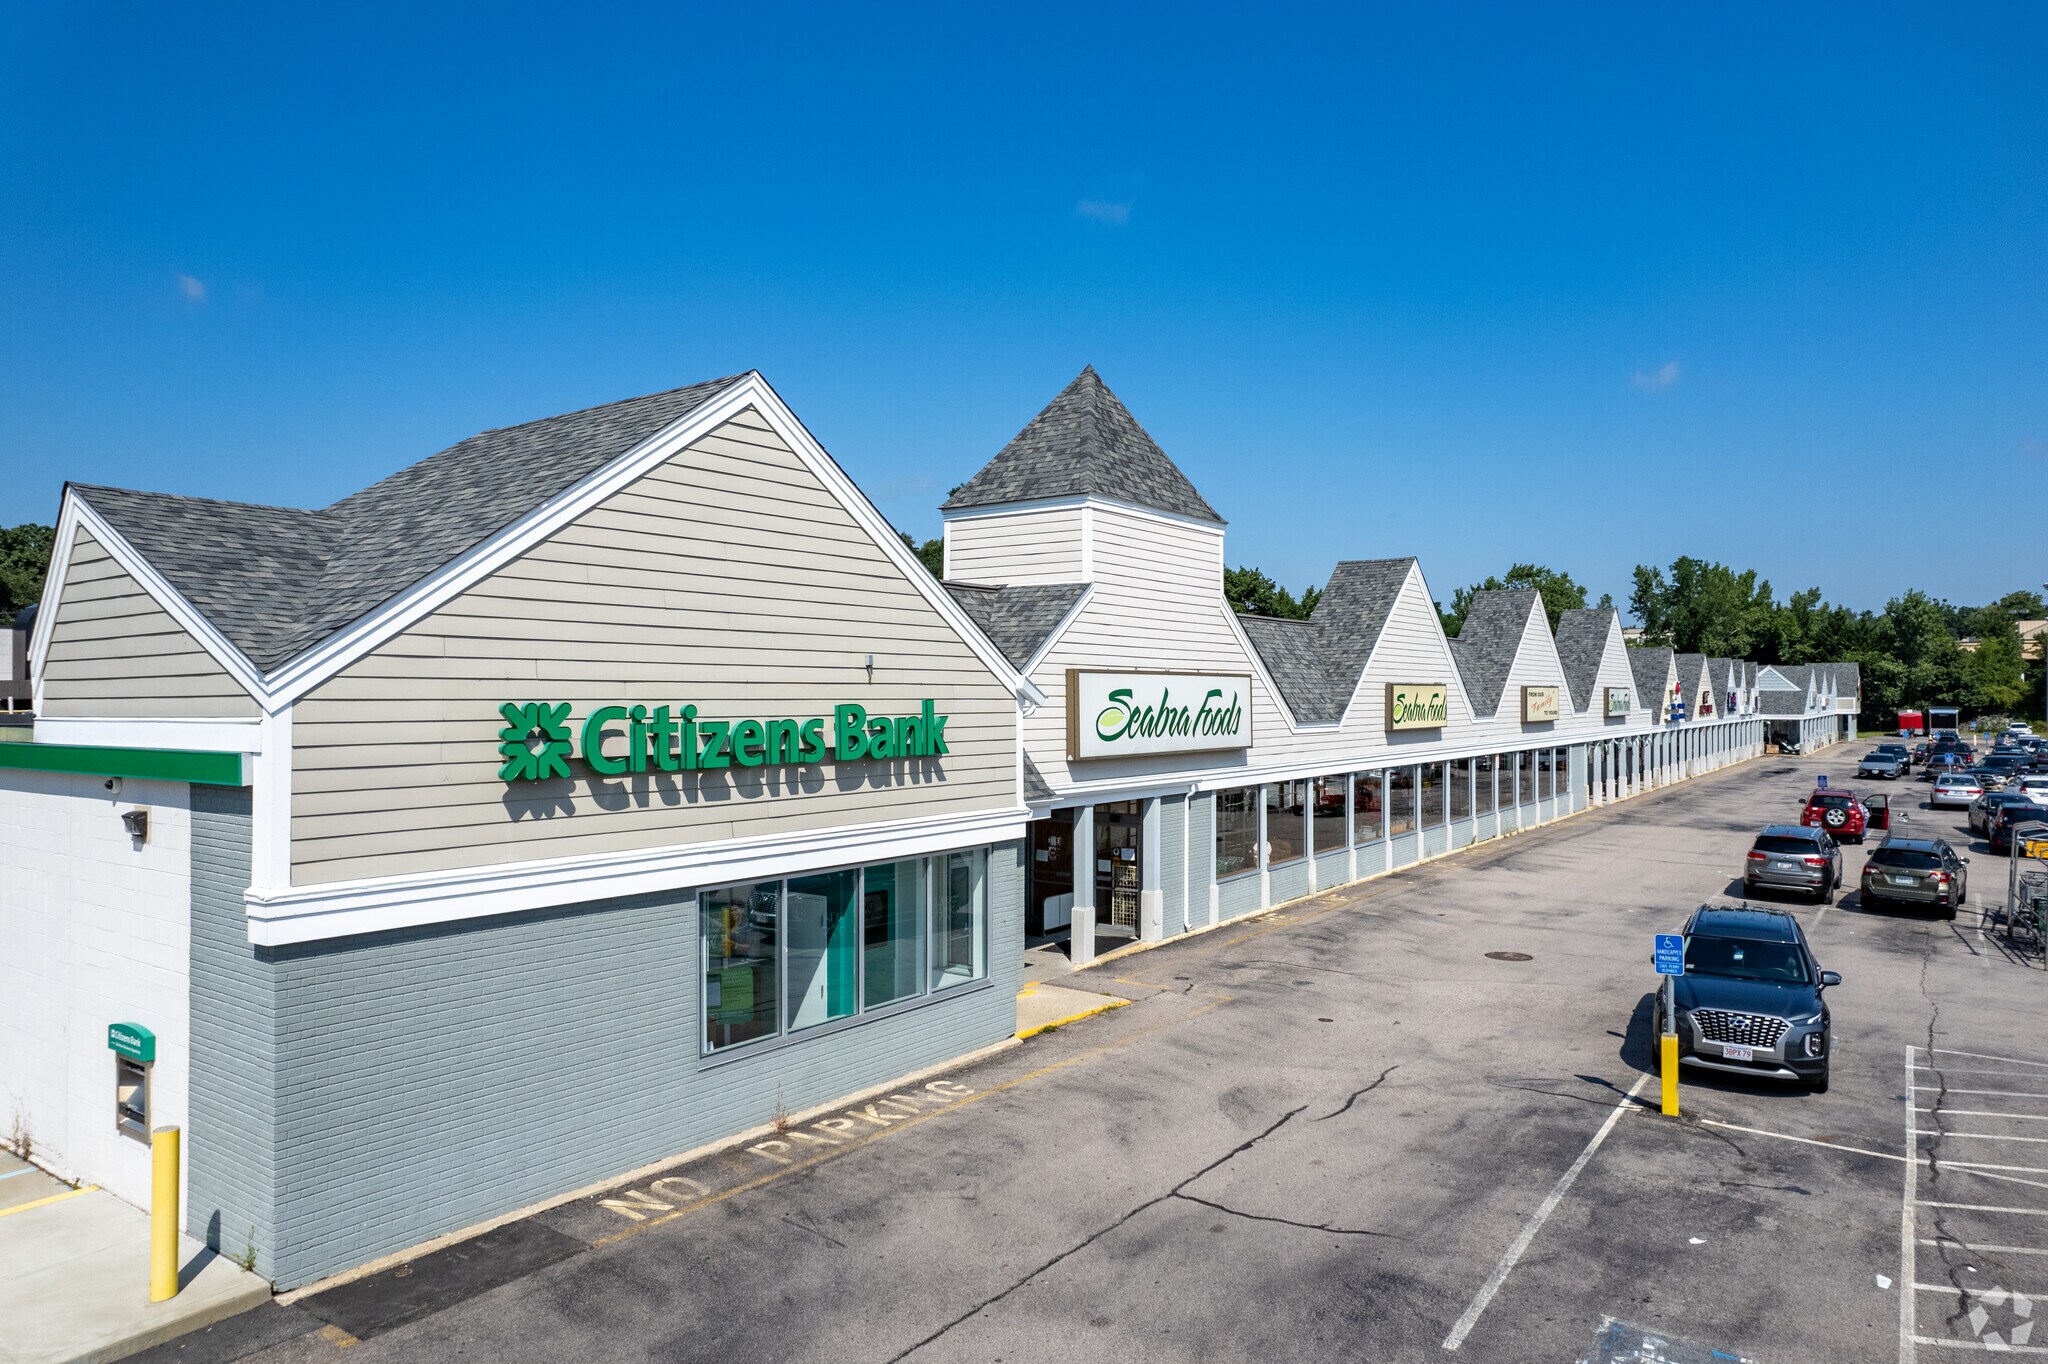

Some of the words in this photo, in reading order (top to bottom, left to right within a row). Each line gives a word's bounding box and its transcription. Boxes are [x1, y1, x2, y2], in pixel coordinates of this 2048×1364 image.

[1096, 686, 1192, 742] Seabra
[1193, 688, 1242, 738] Foods
[1393, 691, 1426, 724] Seabra
[581, 703, 826, 776] Citizens
[834, 698, 950, 762] Bank
[1656, 948, 1682, 956] HANDICAPPED
[596, 1177, 711, 1222] NO
[747, 1080, 975, 1165] PARKING
